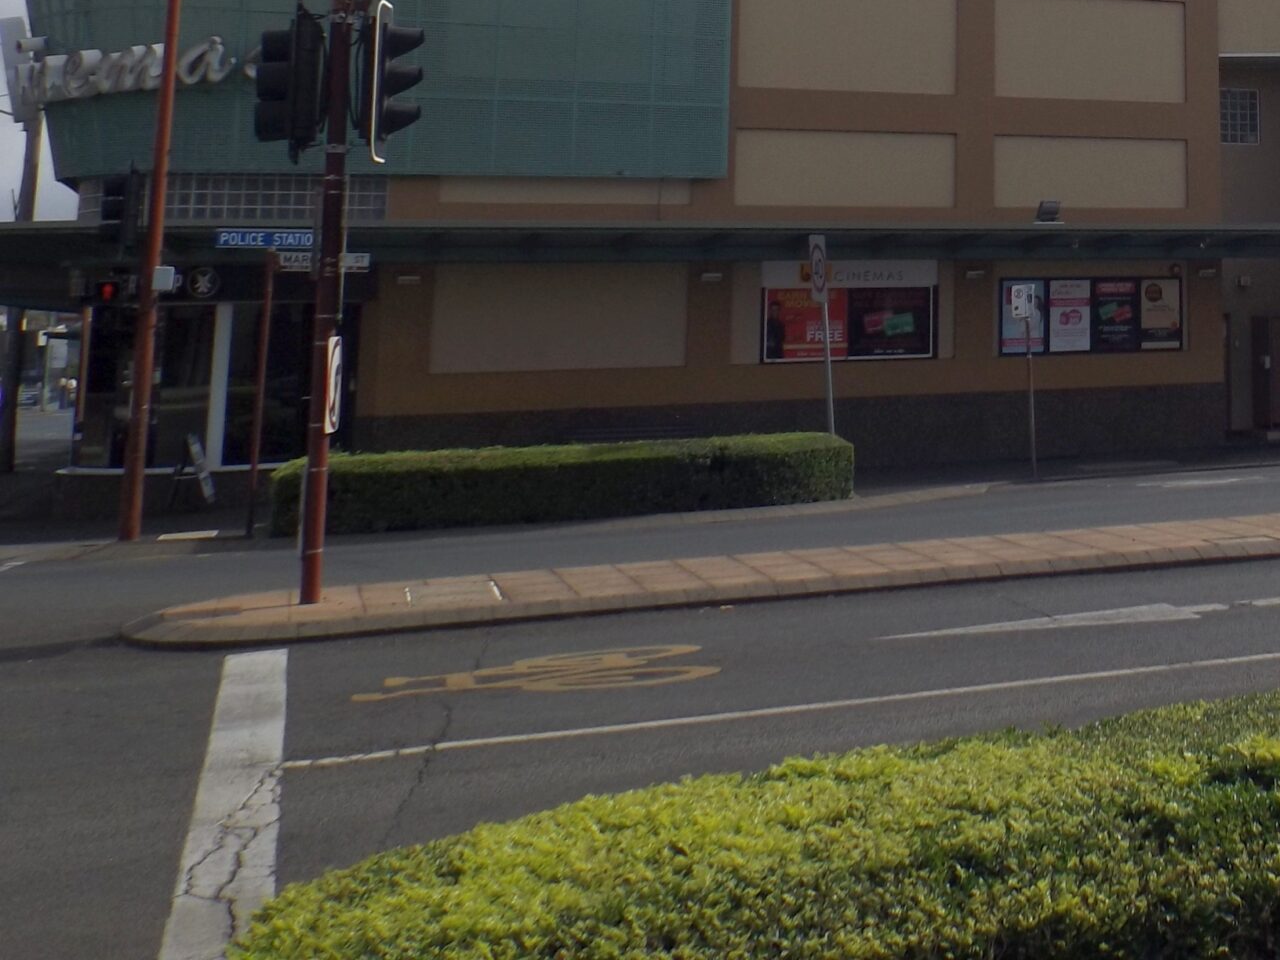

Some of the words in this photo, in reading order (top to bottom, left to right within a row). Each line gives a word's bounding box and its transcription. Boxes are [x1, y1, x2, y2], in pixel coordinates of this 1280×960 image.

[220, 232, 265, 246] POLICE
[272, 232, 314, 246] STATIO
[834, 270, 905, 282] CINEMAS
[806, 330, 845, 343] FREE
